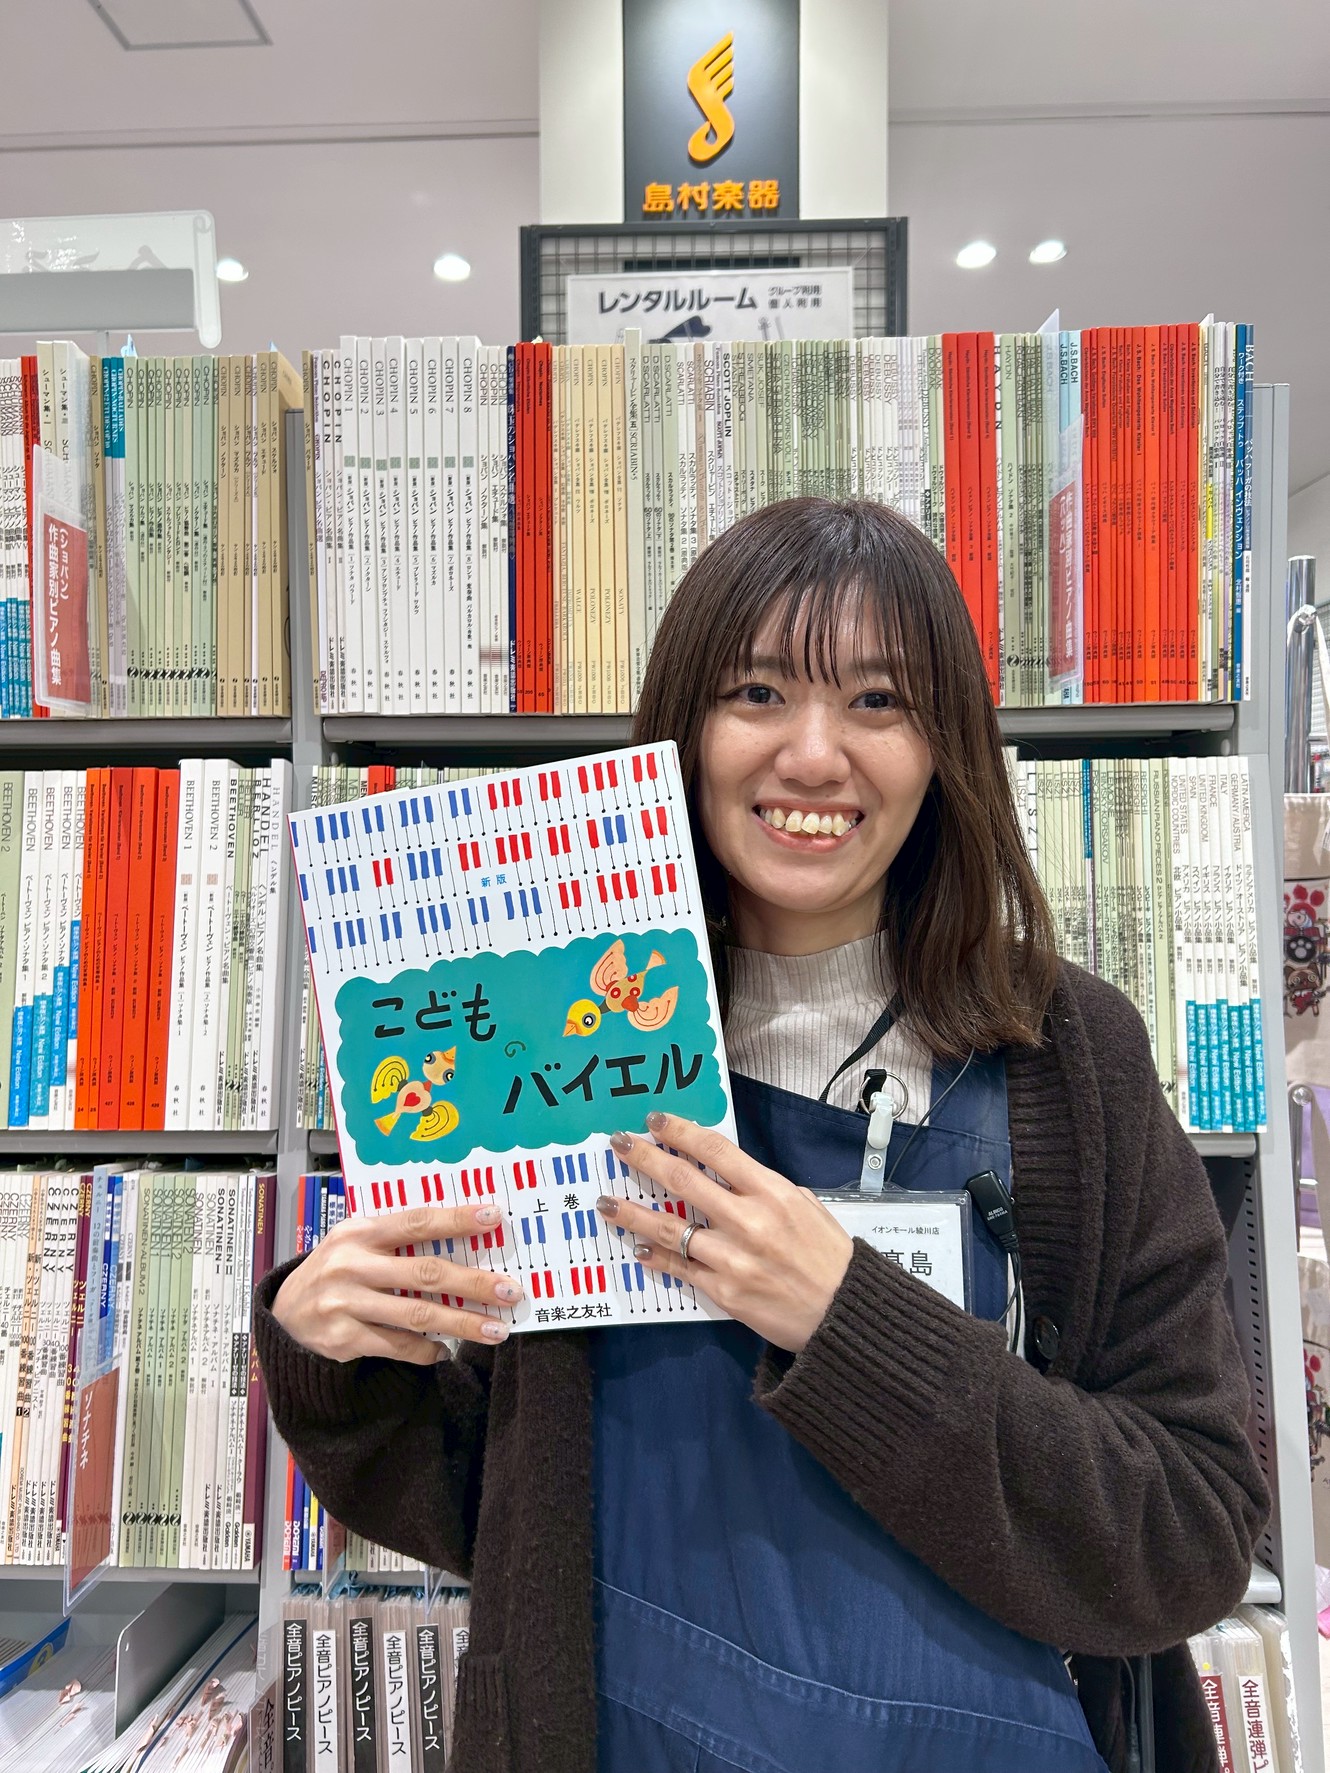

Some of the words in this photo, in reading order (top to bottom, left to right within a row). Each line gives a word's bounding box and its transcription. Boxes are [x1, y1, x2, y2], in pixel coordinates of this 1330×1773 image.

[642, 179, 780, 212] 島村楽器
[598, 287, 757, 314] レンタルルーム
[344, 358, 353, 402] CHOPIN
[360, 360, 369, 404] CHOPIN
[375, 361, 384, 405] CHOPIN
[389, 358, 398, 402] CHOPIN
[409, 360, 418, 403] CHOPIN
[428, 359, 436, 402] CHOPIN
[445, 358, 454, 402] CHOPIN
[463, 358, 472, 402] CHOPIN
[490, 363, 498, 406] CHOPIN
[677, 361, 685, 406] SCARLATTI
[686, 361, 694, 405] SCARLATTI
[705, 359, 714, 411] SCRIABIN
[723, 353, 731, 393] SCOTT
[884, 354, 892, 404] DEBUSSY
[1060, 343, 1068, 385] J.S.BACH
[1070, 342, 1078, 384] J.S.BACH
[1245, 344, 1254, 382] BACH
[126, 367, 134, 409] CHOPIN
[323, 360, 331, 443] CHOPIN
[334, 360, 342, 443] CHOPIN
[994, 345, 1002, 430] HAYDN
[724, 395, 732, 437] JOPLIN
[1235, 460, 1244, 486] バッハ
[48, 523, 61, 685] 作曲家別ピアノ曲集
[1171, 775, 1179, 806] NORDIC
[1178, 774, 1186, 803] UNITED
[1198, 774, 1206, 803] UNITED
[1209, 775, 1217, 808] FRANCE
[1240, 773, 1248, 796] LATIN
[2, 782, 13, 843] BEETHOVEN
[26, 788, 37, 851] BEETHOVEN
[44, 787, 55, 851] BEETHOVEN
[62, 786, 72, 850] BEETHOVEN
[75, 786, 85, 850] BEETHOVEN
[185, 780, 195, 840] BEETHOVEN
[210, 780, 220, 840] BEETHOVEN
[228, 778, 237, 859] BEETHOVEN
[253, 779, 261, 859] BERLIOZ
[260, 777, 271, 854] HANDEL
[271, 787, 280, 851] HANDEL
[1172, 808, 1180, 854] COUNTRIES
[1179, 805, 1187, 834] STATES
[1200, 805, 1208, 843] KINGDOM
[1242, 797, 1250, 832] AMERICA
[24, 874, 34, 919] ベートーヴェン
[43, 874, 52, 919] ベートーヴェン
[481, 874, 507, 887] 新版
[1182, 864, 1190, 893] アメリカ
[1192, 865, 1200, 893] スペイン
[1202, 864, 1211, 893] イギリス
[1212, 865, 1221, 893] フランス
[1224, 865, 1232, 893] イタリア
[371, 982, 497, 1042] こども
[504, 1040, 526, 1058] の
[198, 1085, 206, 1116] 春秋社
[502, 1043, 703, 1115] バイエル
[193, 1192, 204, 1255] SONATINEN
[205, 1192, 216, 1256] SONATINEN
[215, 1188, 225, 1261] SONATINEN
[226, 1189, 236, 1262] SONATINEN
[257, 1183, 265, 1235] SONATINEN
[533, 1193, 580, 1214] 上巻
[57, 1188, 69, 1272] CZERNY
[66, 1188, 79, 1271] CZERNY
[140, 1188, 150, 1286] SONATINEN-ALBUM
[871, 1225, 940, 1235] イオンモール綾川店
[100, 1263, 109, 1308] CZERNY
[535, 1303, 613, 1323] 音楽之友社
[80, 1391, 93, 1470] ソナチネ
[286, 1622, 303, 1742] 全音ピアノピース
[315, 1634, 333, 1755] 全音ピアノピース
[352, 1621, 372, 1742] 全音ピアノピース
[386, 1635, 406, 1756] 全音ピアノピース
[418, 1629, 440, 1751] 全音ピアノピース
